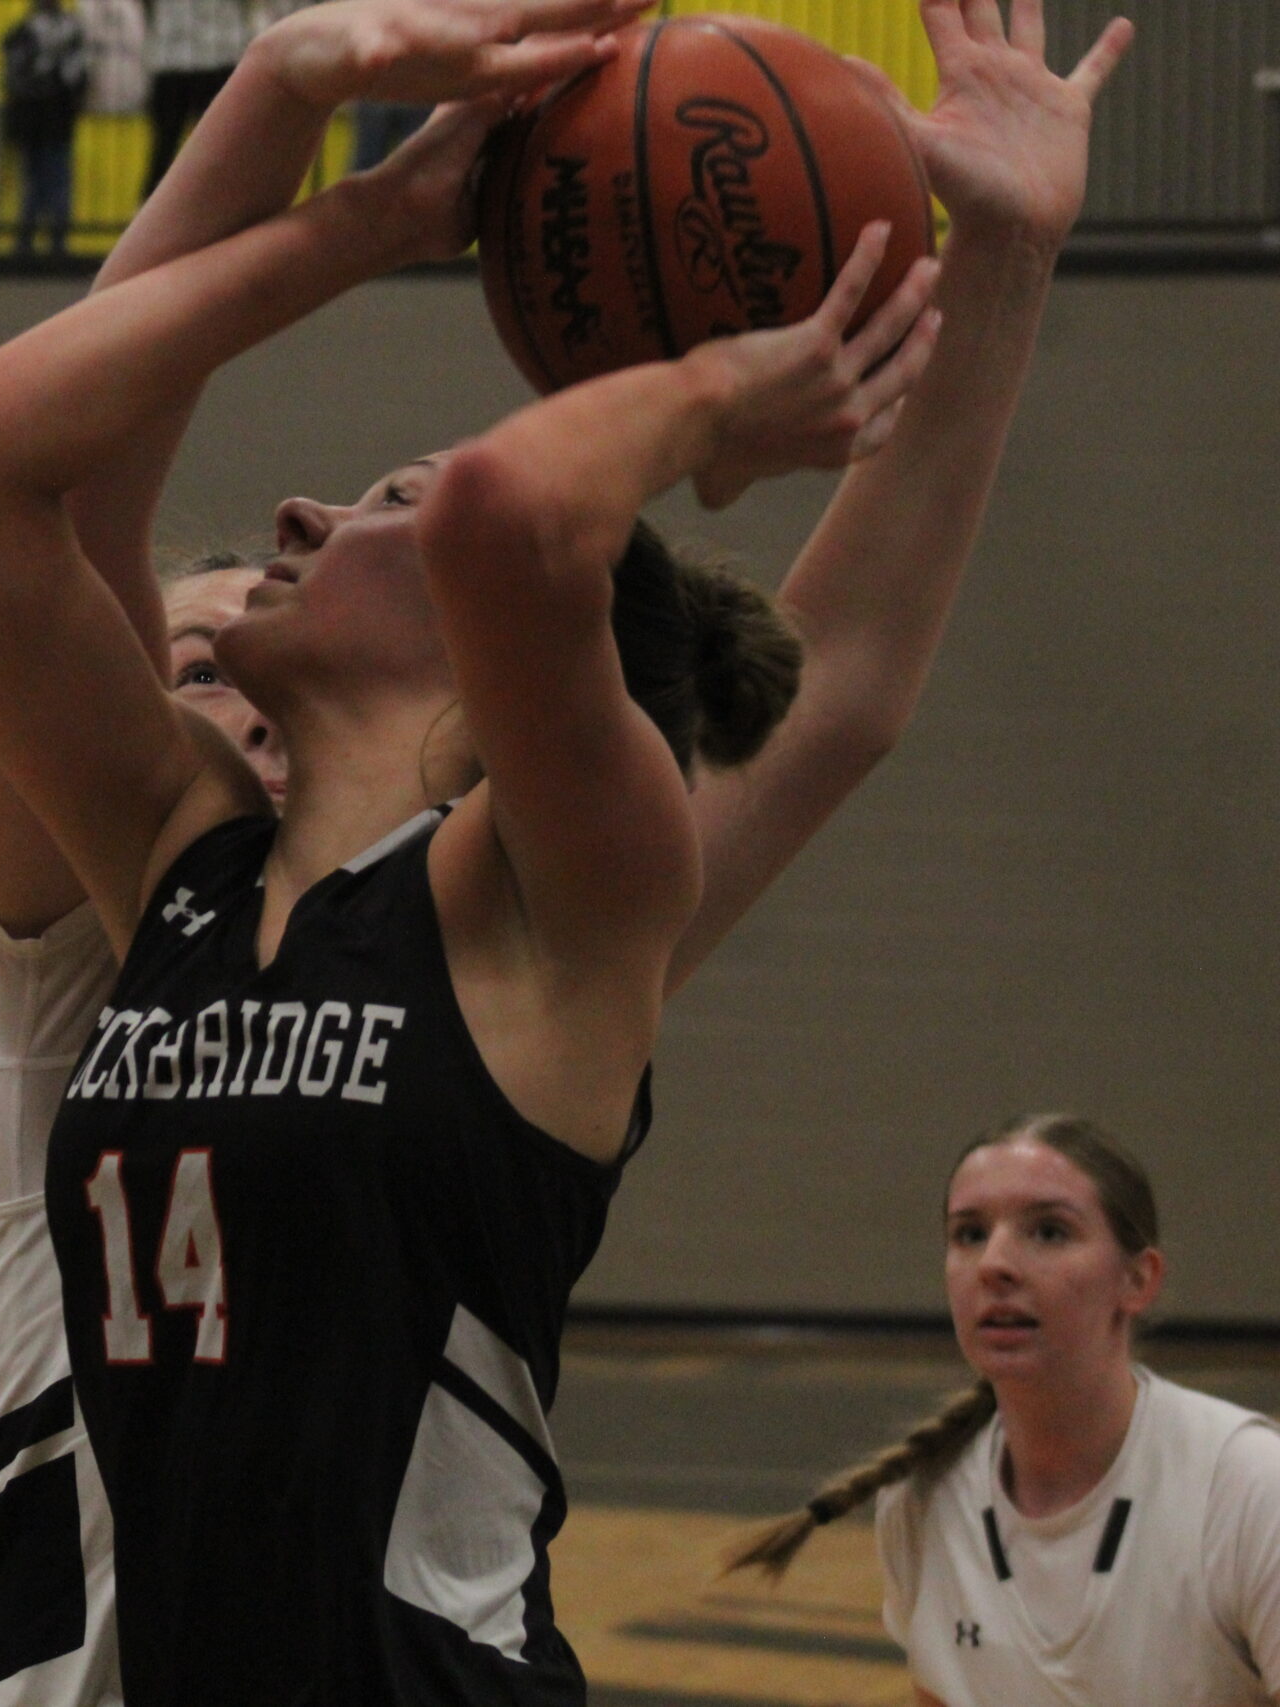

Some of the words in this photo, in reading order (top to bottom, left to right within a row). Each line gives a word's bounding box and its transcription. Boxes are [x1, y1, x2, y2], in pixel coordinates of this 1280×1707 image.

[675, 95, 803, 336] Rawlin
[66, 998, 407, 1105] CKBRIDGE
[83, 1145, 229, 1367] 14
